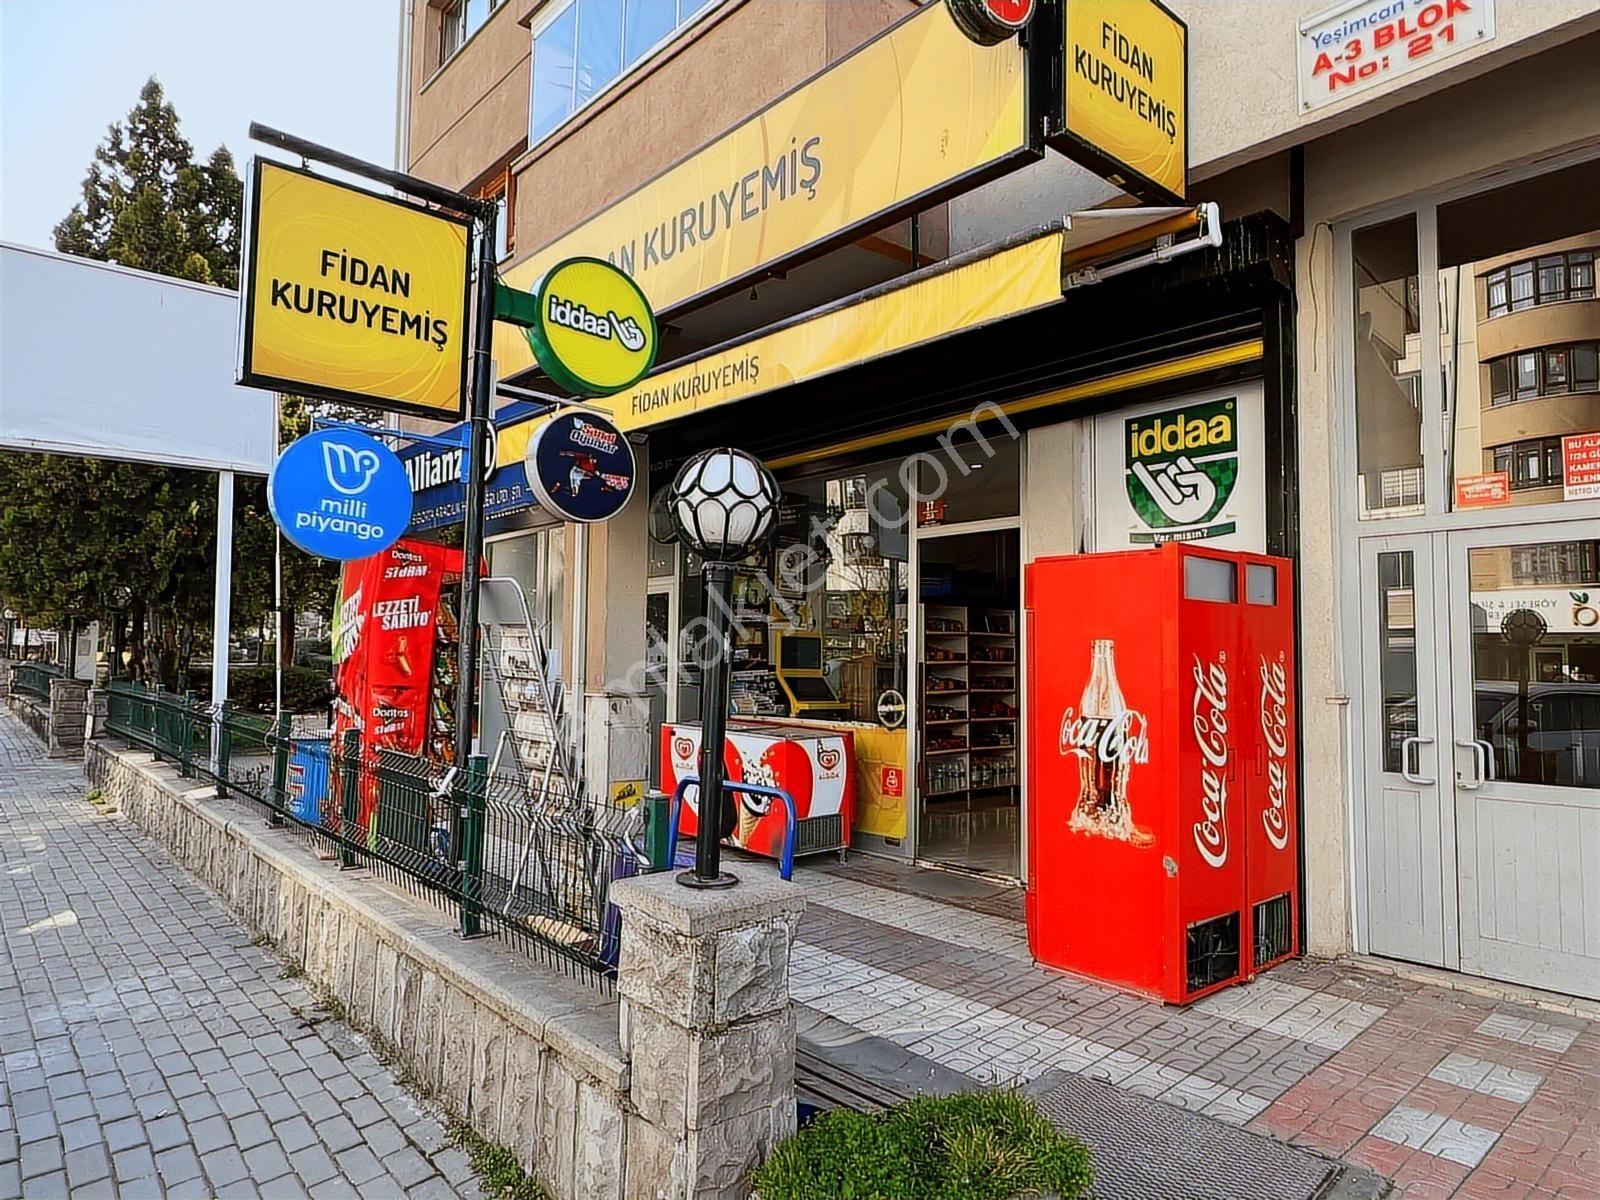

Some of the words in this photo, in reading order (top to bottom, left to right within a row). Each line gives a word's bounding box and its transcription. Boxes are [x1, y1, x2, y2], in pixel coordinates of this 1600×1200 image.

[1102, 21, 1154, 83] FİDAN
[1311, 0, 1405, 49] Yeşimcan
[1312, 38, 1363, 76] A-3
[1374, 0, 1472, 50] BLOK
[1329, 55, 1390, 91] No:
[1407, 23, 1455, 60] 21
[1075, 44, 1177, 145] KURUYEMİŞ
[643, 136, 823, 271] KURUYEMİŞ
[320, 248, 411, 299] FİDAN
[270, 278, 450, 352] KURUYEMİŞ
[548, 295, 612, 339] iddaa
[631, 381, 671, 416] FİDAN
[673, 354, 761, 402] KURUYEMİŞ
[1131, 413, 1232, 458] iddaa
[295, 509, 385, 541] piyango
[319, 498, 367, 520] milli
[372, 594, 420, 618] LEZZETİ
